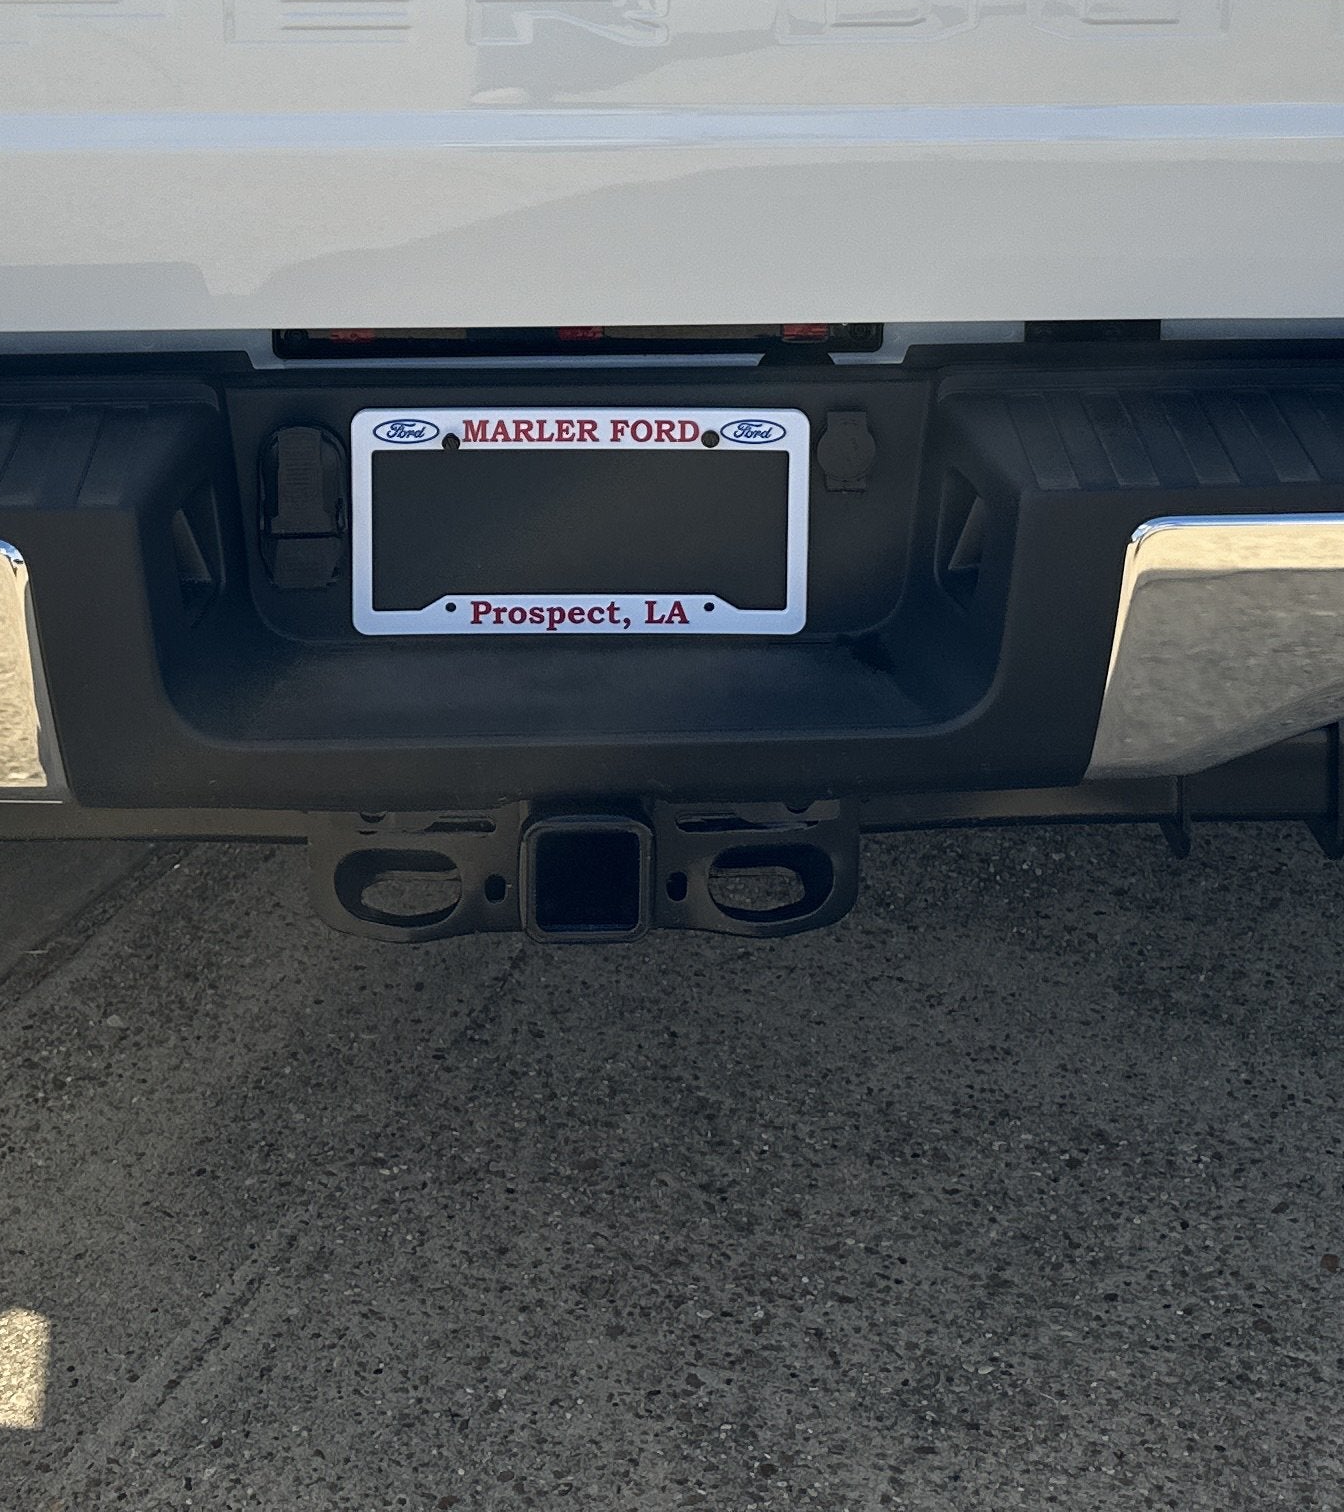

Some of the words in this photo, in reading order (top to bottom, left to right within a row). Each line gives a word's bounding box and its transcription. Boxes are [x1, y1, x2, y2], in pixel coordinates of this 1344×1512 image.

[386, 422, 426, 439] Ford
[462, 419, 599, 443] MARLER
[610, 419, 700, 443] FORD
[733, 422, 773, 439] Ford
[470, 600, 632, 631] Prospect,
[644, 600, 690, 625] LA
